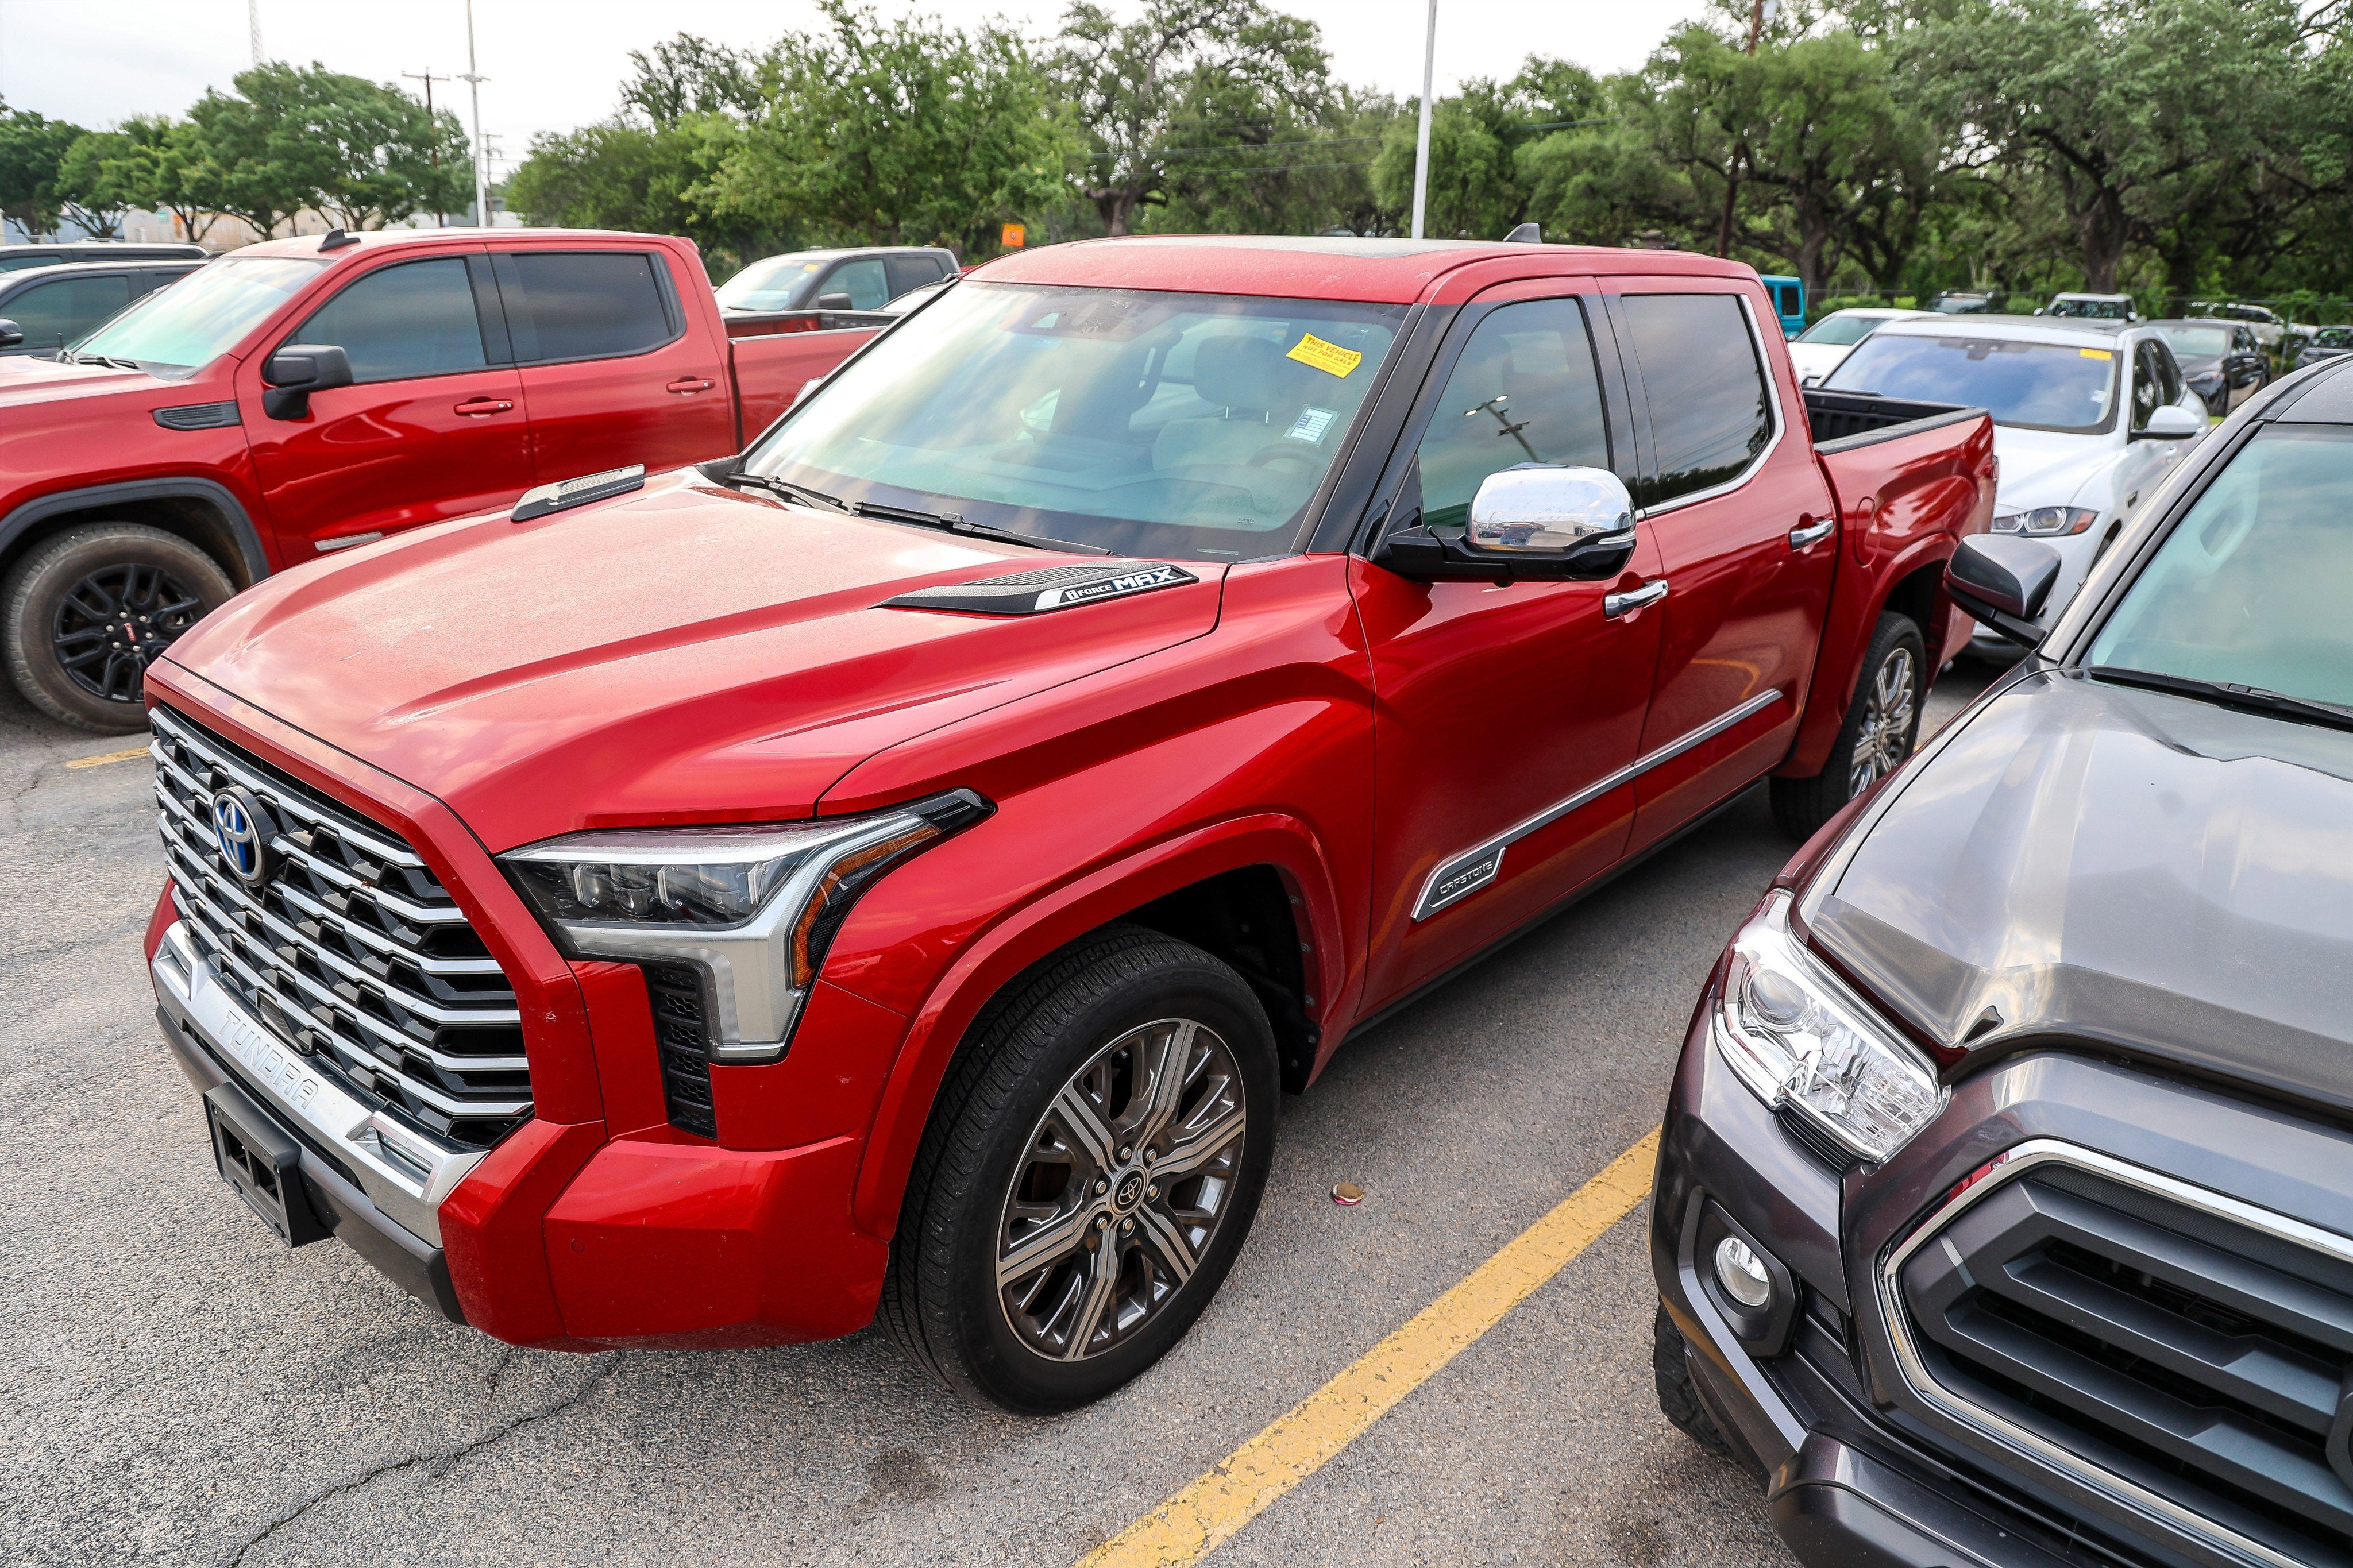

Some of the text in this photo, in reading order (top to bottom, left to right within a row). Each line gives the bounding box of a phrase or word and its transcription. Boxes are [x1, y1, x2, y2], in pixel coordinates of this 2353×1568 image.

[1307, 337, 1325, 348] THIS
[1327, 346, 1359, 362] VEHICLE
[1319, 350, 1333, 358] FOR
[1334, 357, 1352, 365] SALE
[1113, 569, 1177, 591] MAX
[1440, 860, 1493, 894] CAPSTONE
[217, 1010, 318, 1110] TUNDRA
